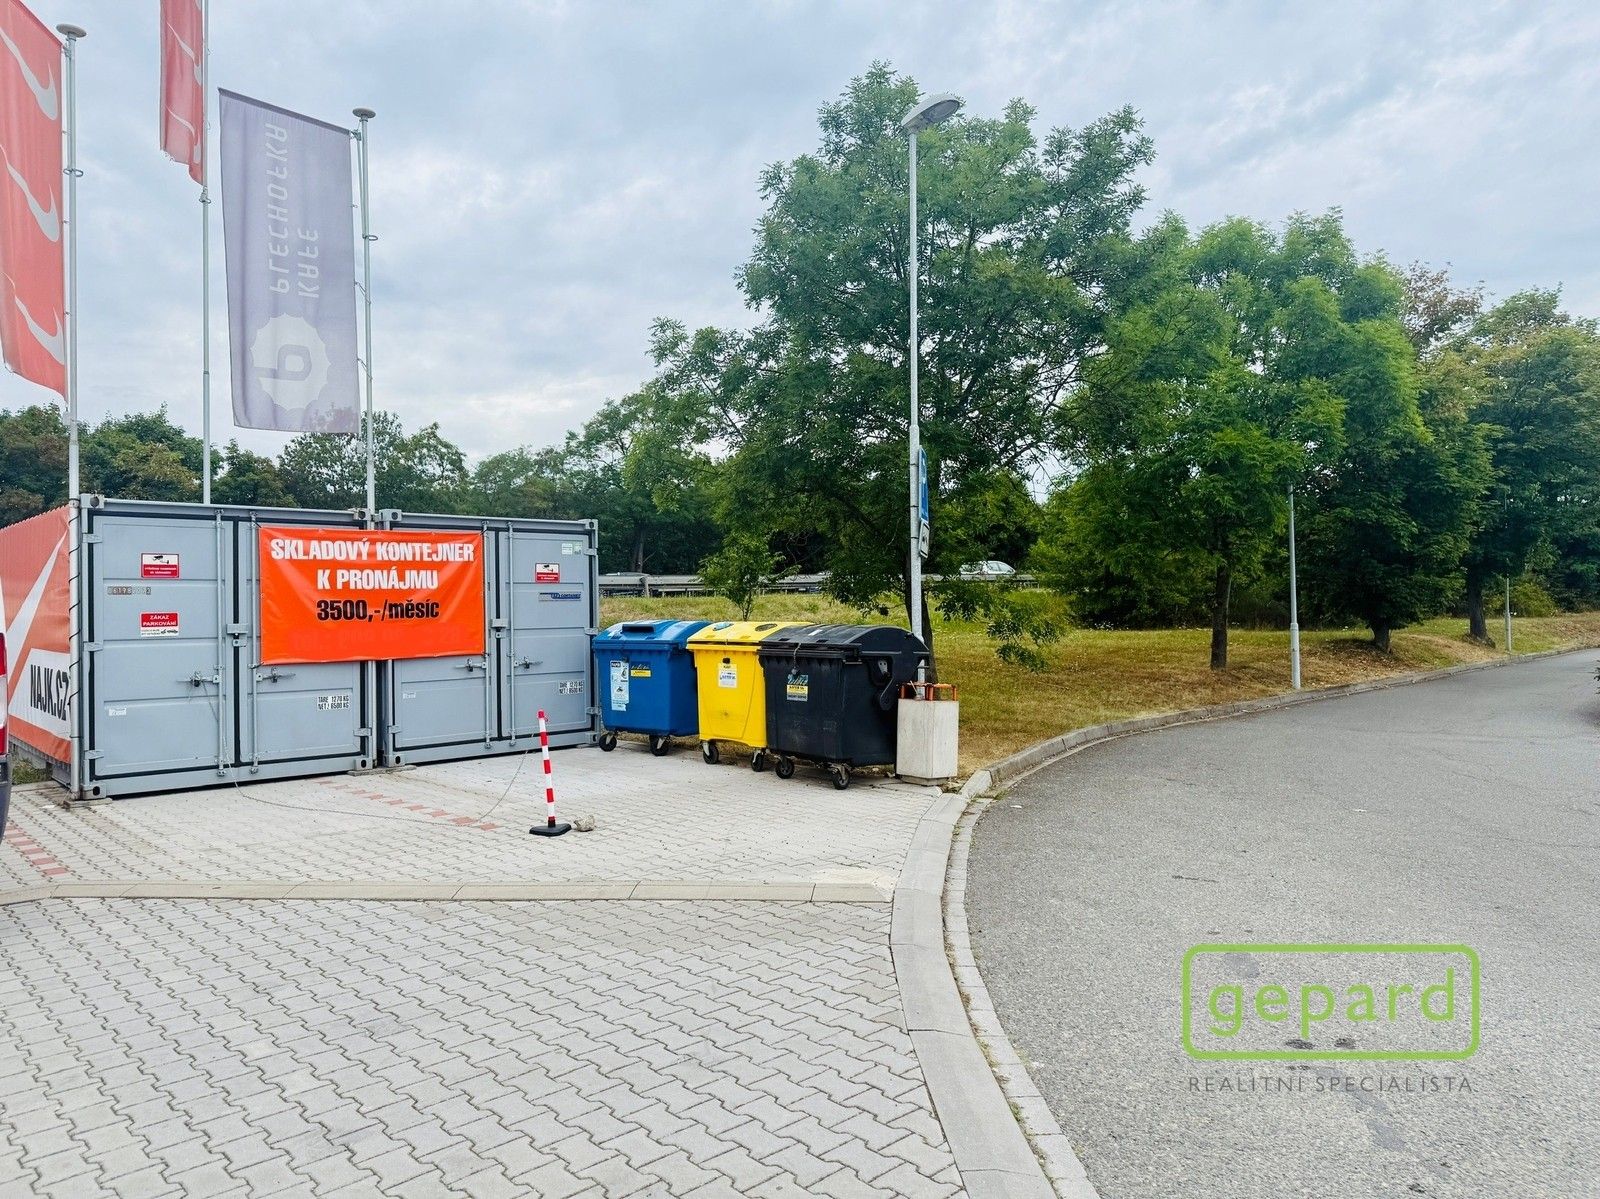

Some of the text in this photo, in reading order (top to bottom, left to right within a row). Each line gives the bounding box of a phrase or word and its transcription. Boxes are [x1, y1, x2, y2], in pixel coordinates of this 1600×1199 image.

[270, 537, 475, 562] SKLADOVÝ KONTEJNER
[317, 566, 439, 590] K PRONÁJMU
[316, 599, 440, 622] 3500,-/měsíc
